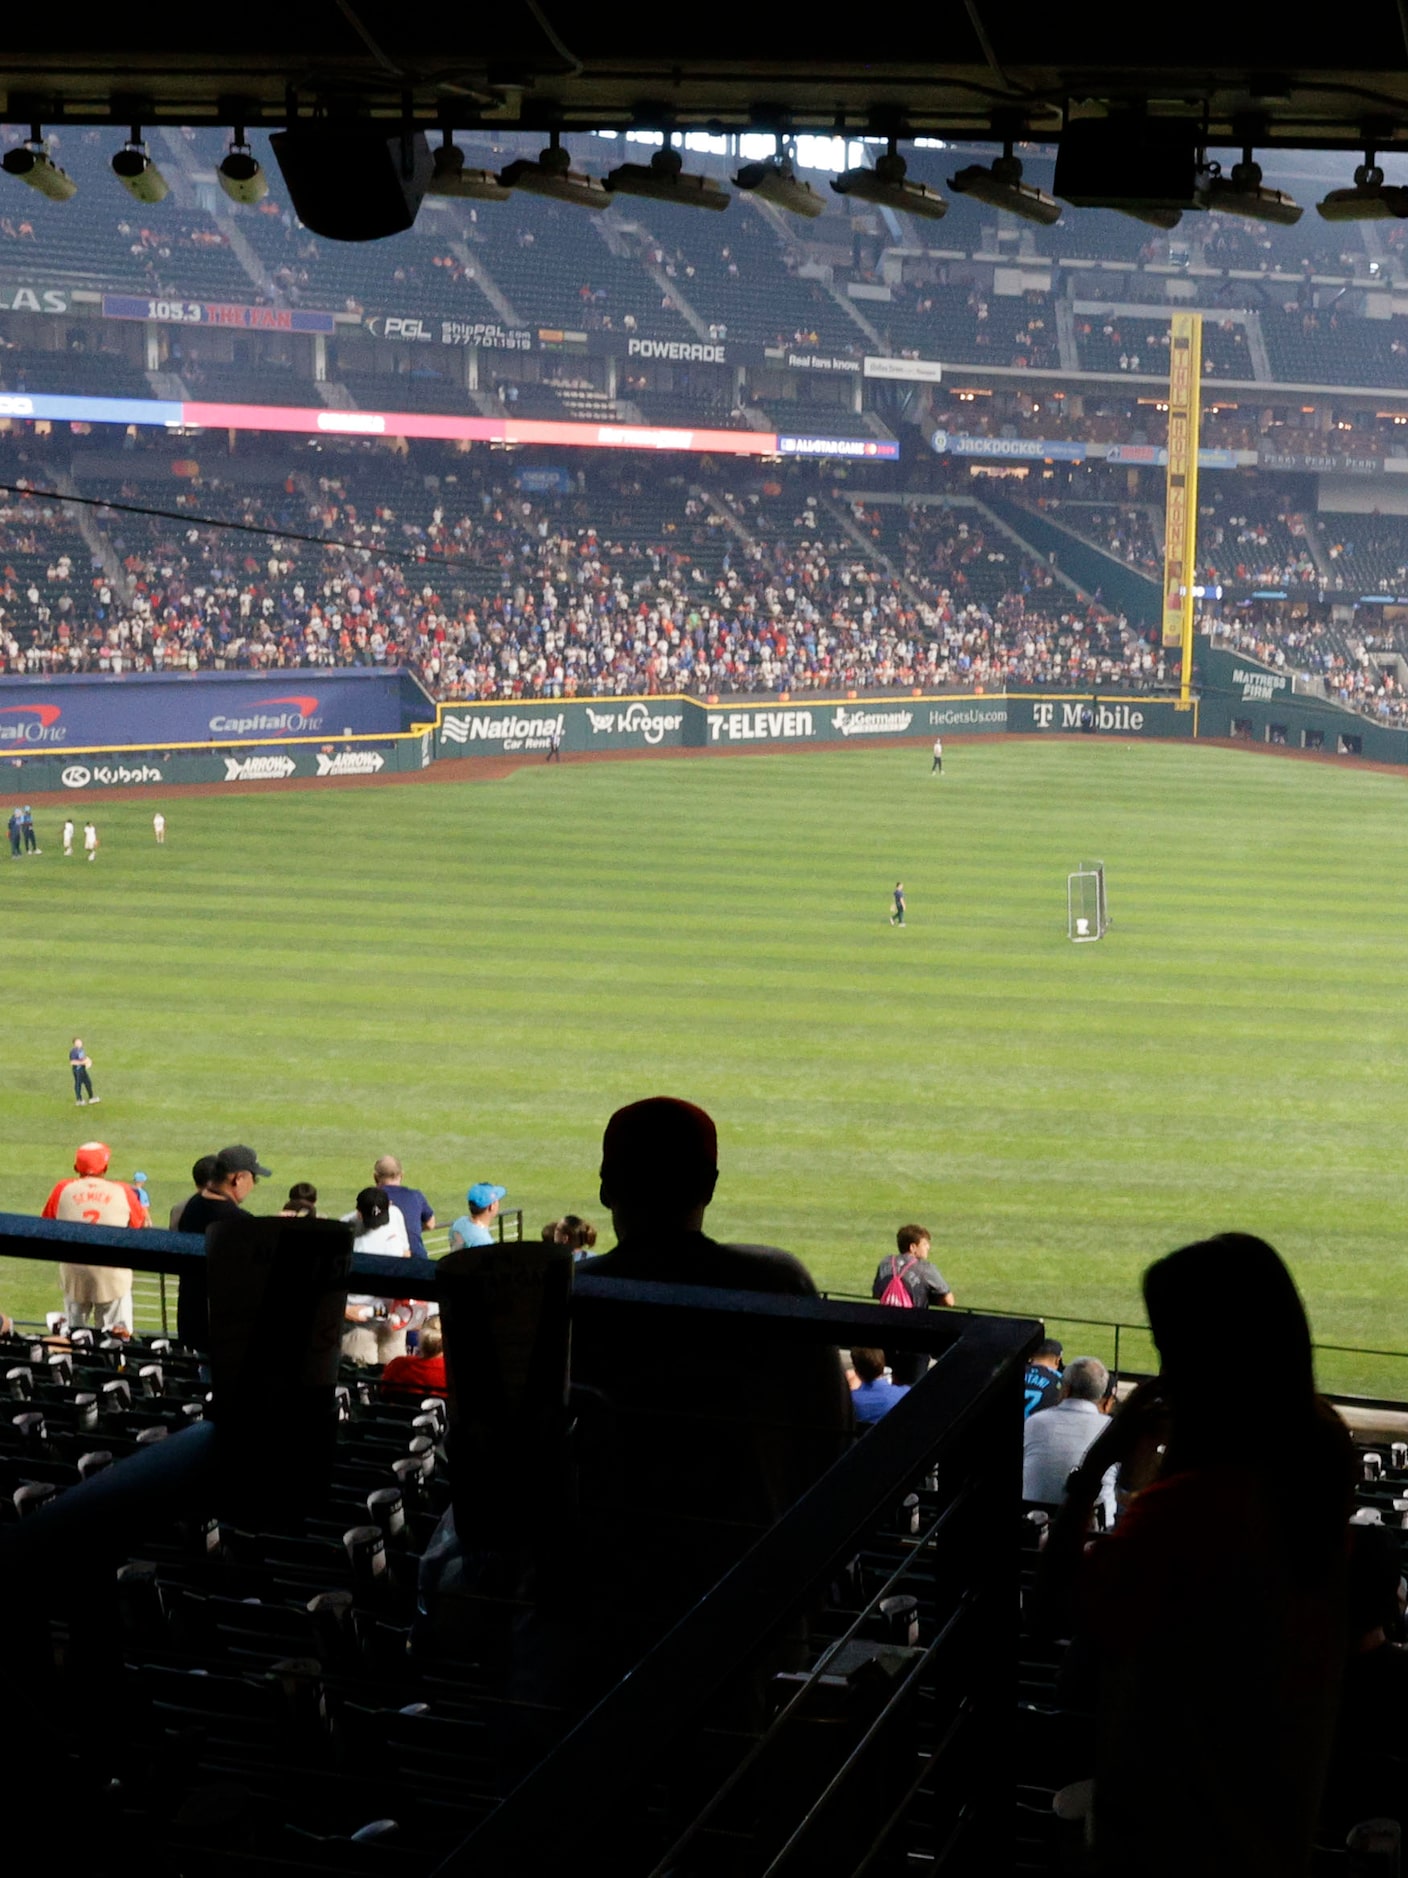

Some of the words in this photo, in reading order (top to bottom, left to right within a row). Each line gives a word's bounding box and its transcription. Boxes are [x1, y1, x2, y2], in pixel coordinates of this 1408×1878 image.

[148, 301, 202, 322] 105.3
[205, 304, 246, 327] THE
[249, 308, 293, 329] FAN
[384, 317, 432, 339] PGL
[628, 338, 725, 363] POWERADE
[788, 354, 810, 367] Real
[811, 354, 832, 369] fans
[1232, 669, 1287, 690] MATTRESS
[1243, 684, 1274, 700] FIRM
[617, 702, 684, 745] Kroger
[854, 709, 913, 726] Germania
[929, 709, 1008, 725] HeGetsUs.com
[1033, 702, 1054, 728] T
[470, 713, 564, 740] National
[503, 740, 523, 751] Car
[93, 765, 162, 784] Kubota
